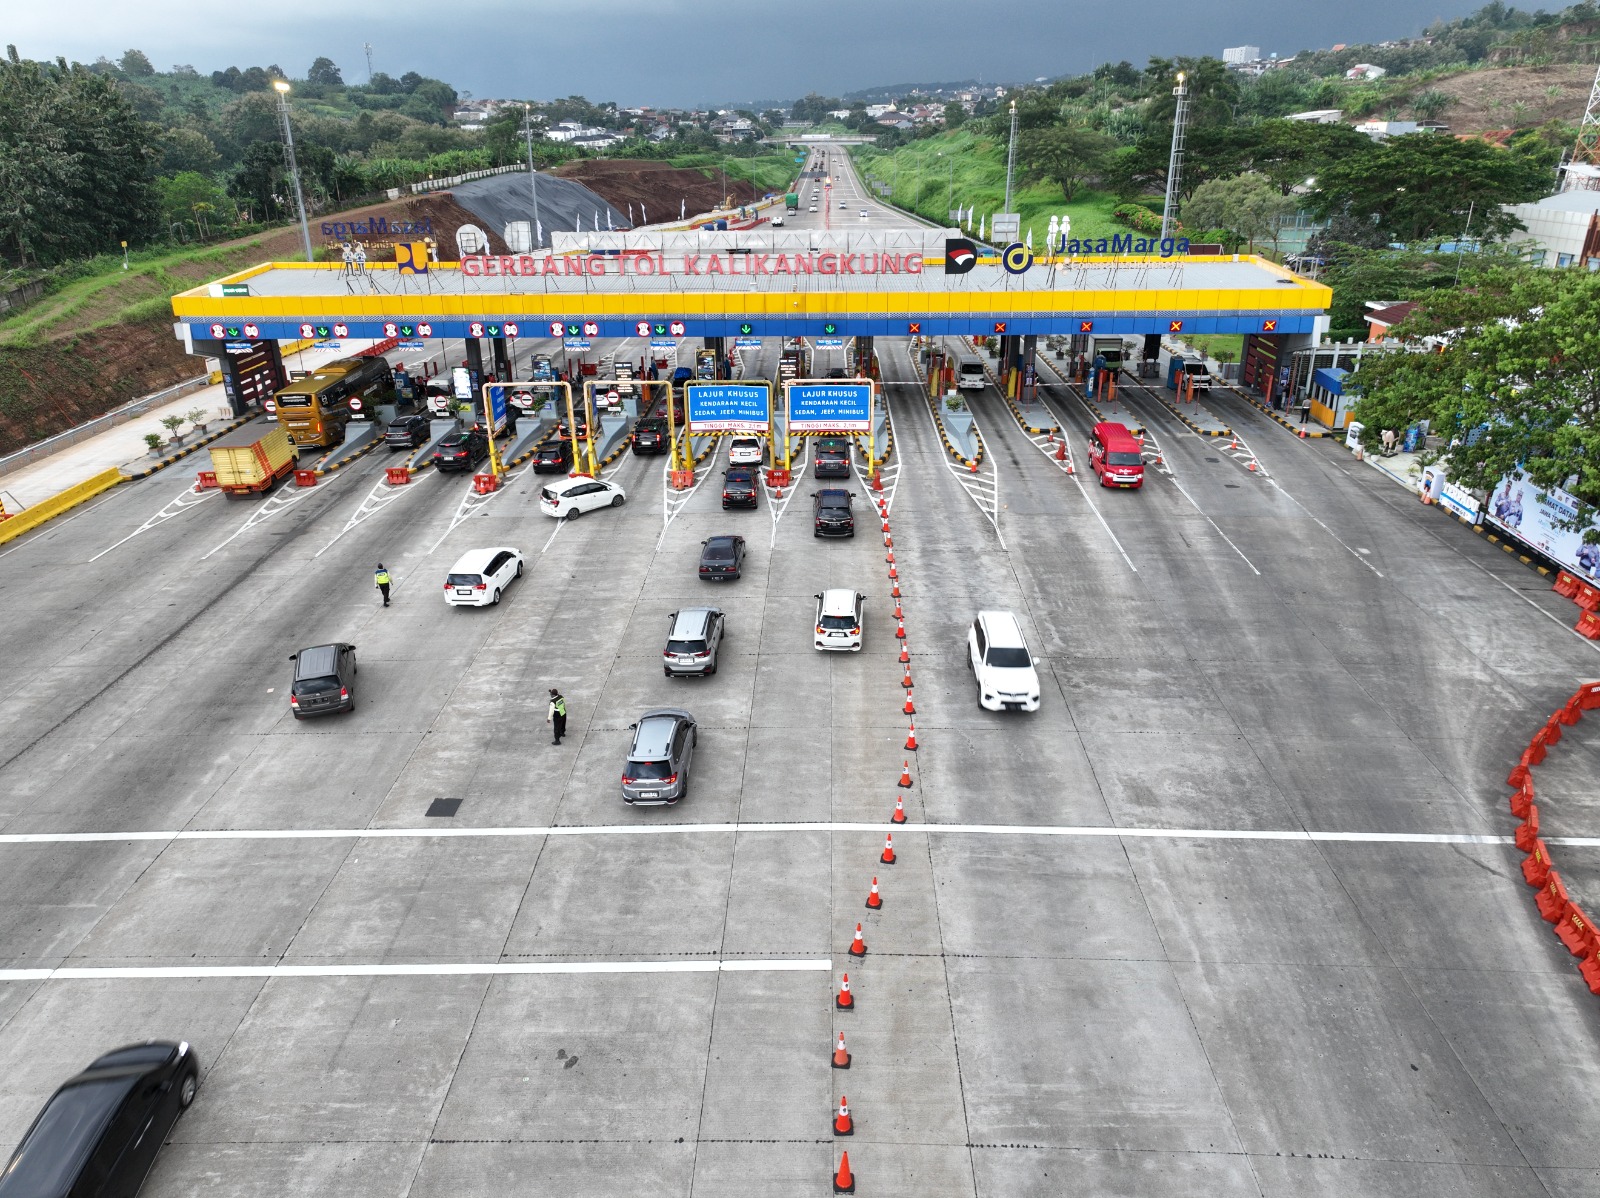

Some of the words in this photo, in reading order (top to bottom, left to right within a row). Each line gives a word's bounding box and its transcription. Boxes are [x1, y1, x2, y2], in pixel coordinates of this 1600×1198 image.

[1056, 234, 1190, 258] JasaMarga
[460, 254, 605, 276] GERBANG
[614, 254, 670, 276] TOL
[684, 253, 922, 276] KALIKANGKUNG
